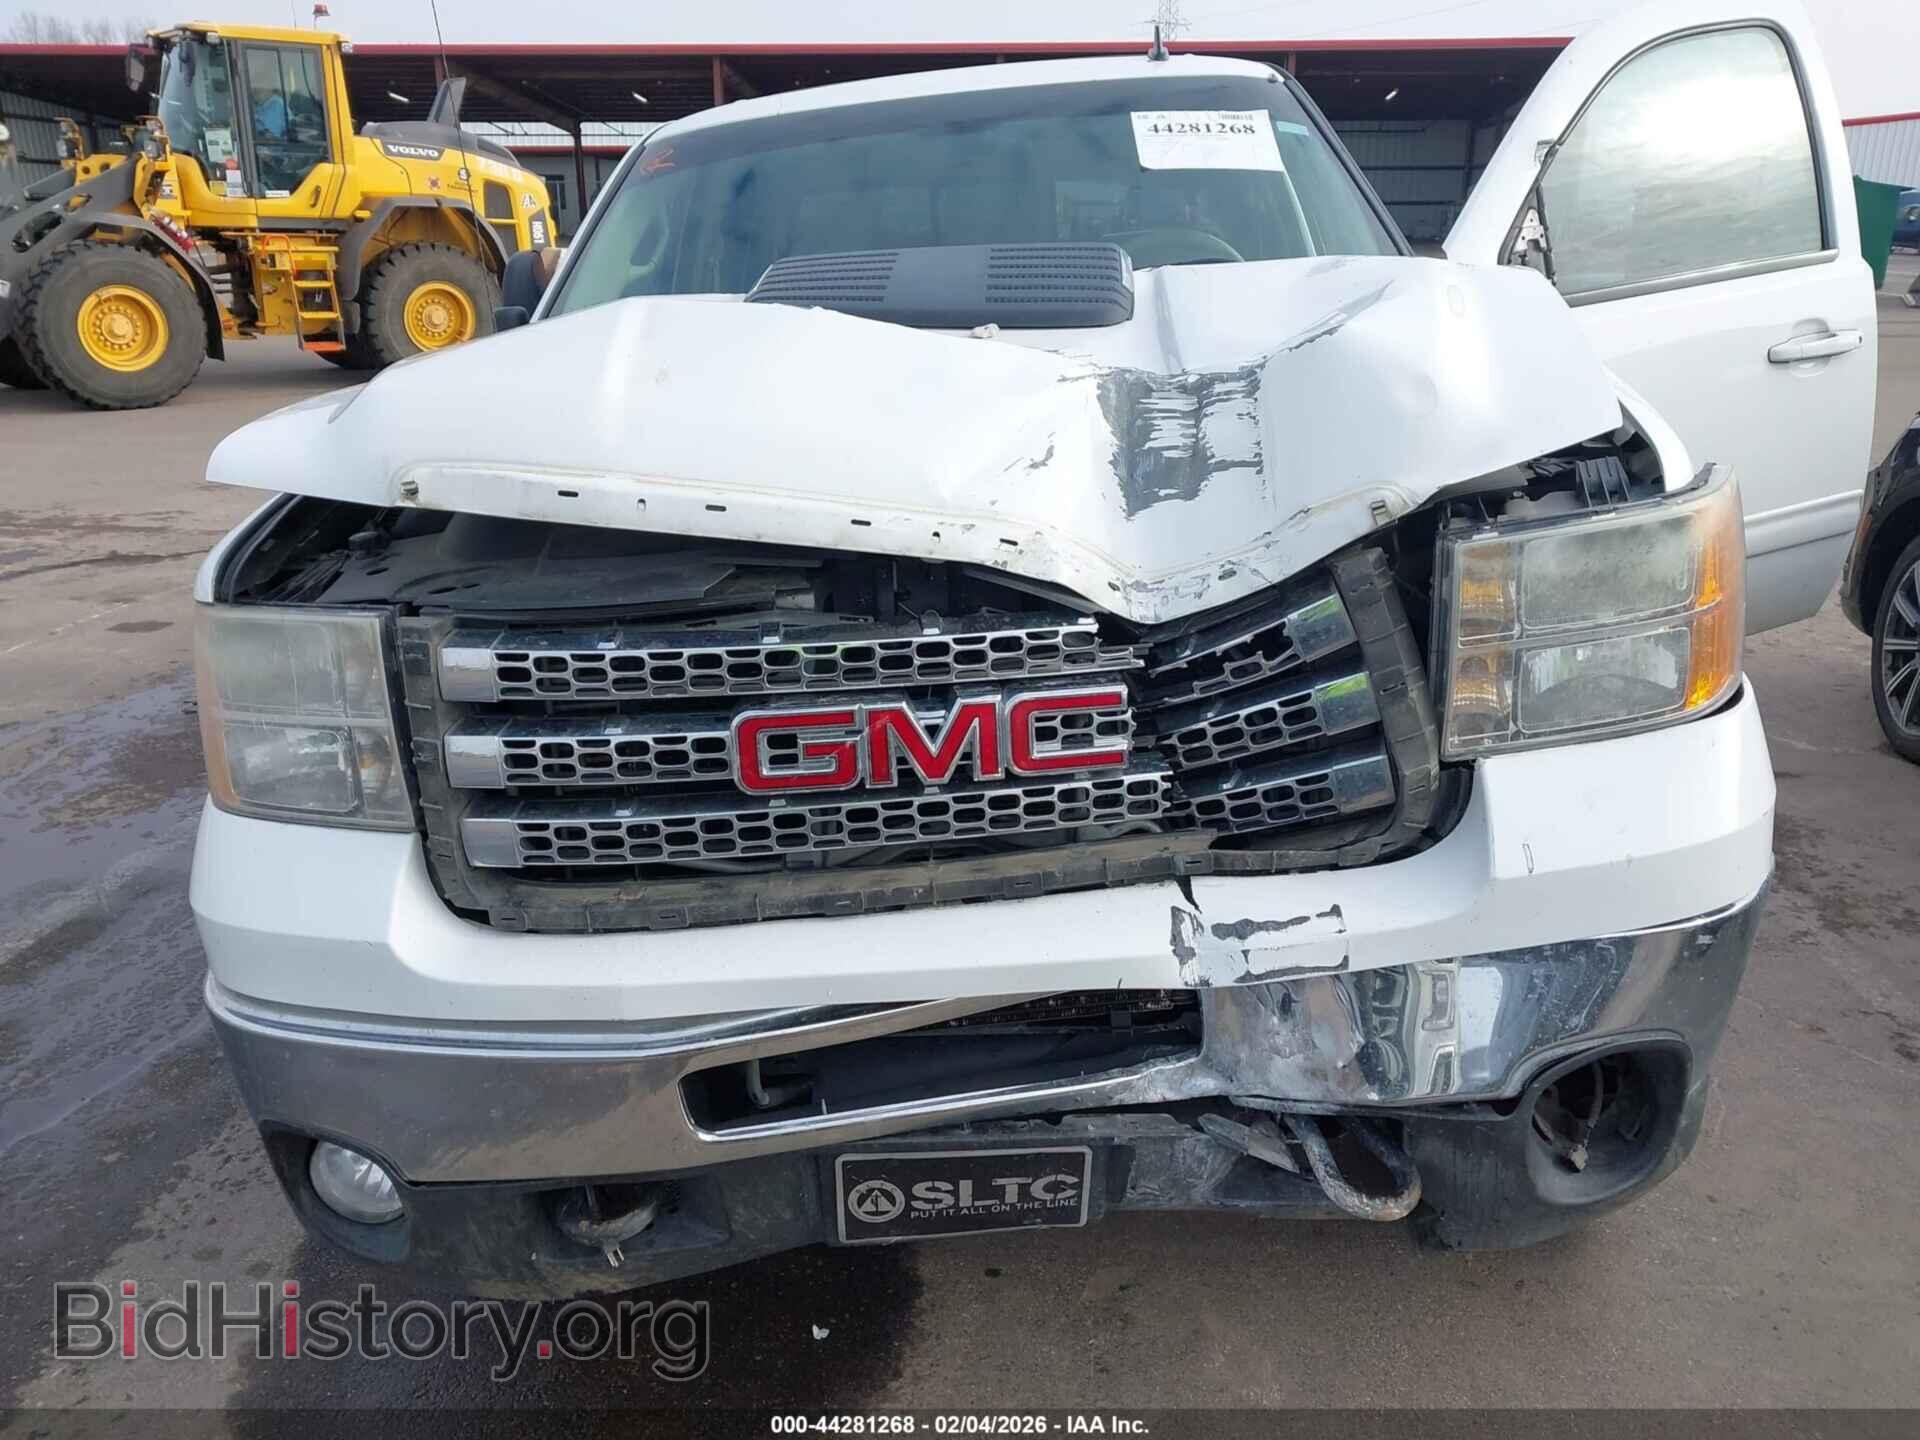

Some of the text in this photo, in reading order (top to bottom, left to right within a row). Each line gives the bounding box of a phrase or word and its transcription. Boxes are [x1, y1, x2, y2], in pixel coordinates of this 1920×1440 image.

[1147, 122, 1256, 134] 44281268
[387, 144, 439, 157] VOLVO
[531, 220, 545, 244] L90H
[731, 684, 1129, 796] GMC
[910, 1174, 1080, 1210] SLTC
[910, 1197, 1079, 1219] PUT IT ALL ON THE LINE
